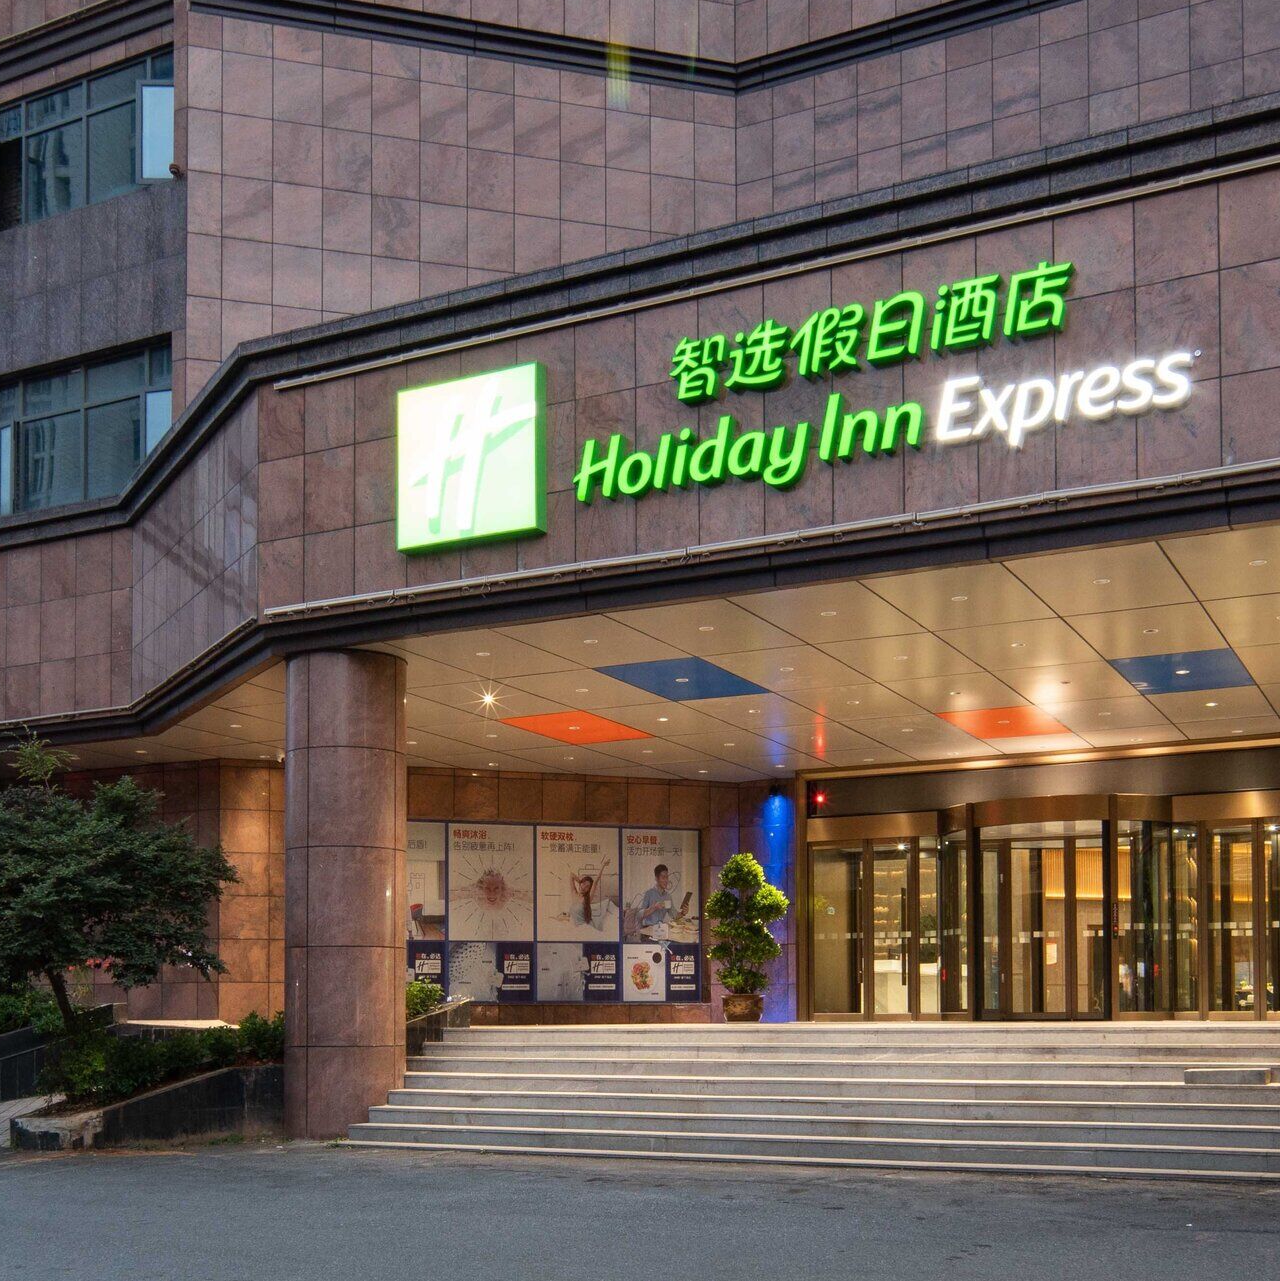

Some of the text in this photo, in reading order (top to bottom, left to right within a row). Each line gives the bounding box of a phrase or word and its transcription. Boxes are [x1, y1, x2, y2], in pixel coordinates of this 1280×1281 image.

[669, 260, 1073, 401] 智选假日酒店
[572, 351, 1193, 503] Holiday Inn Express
